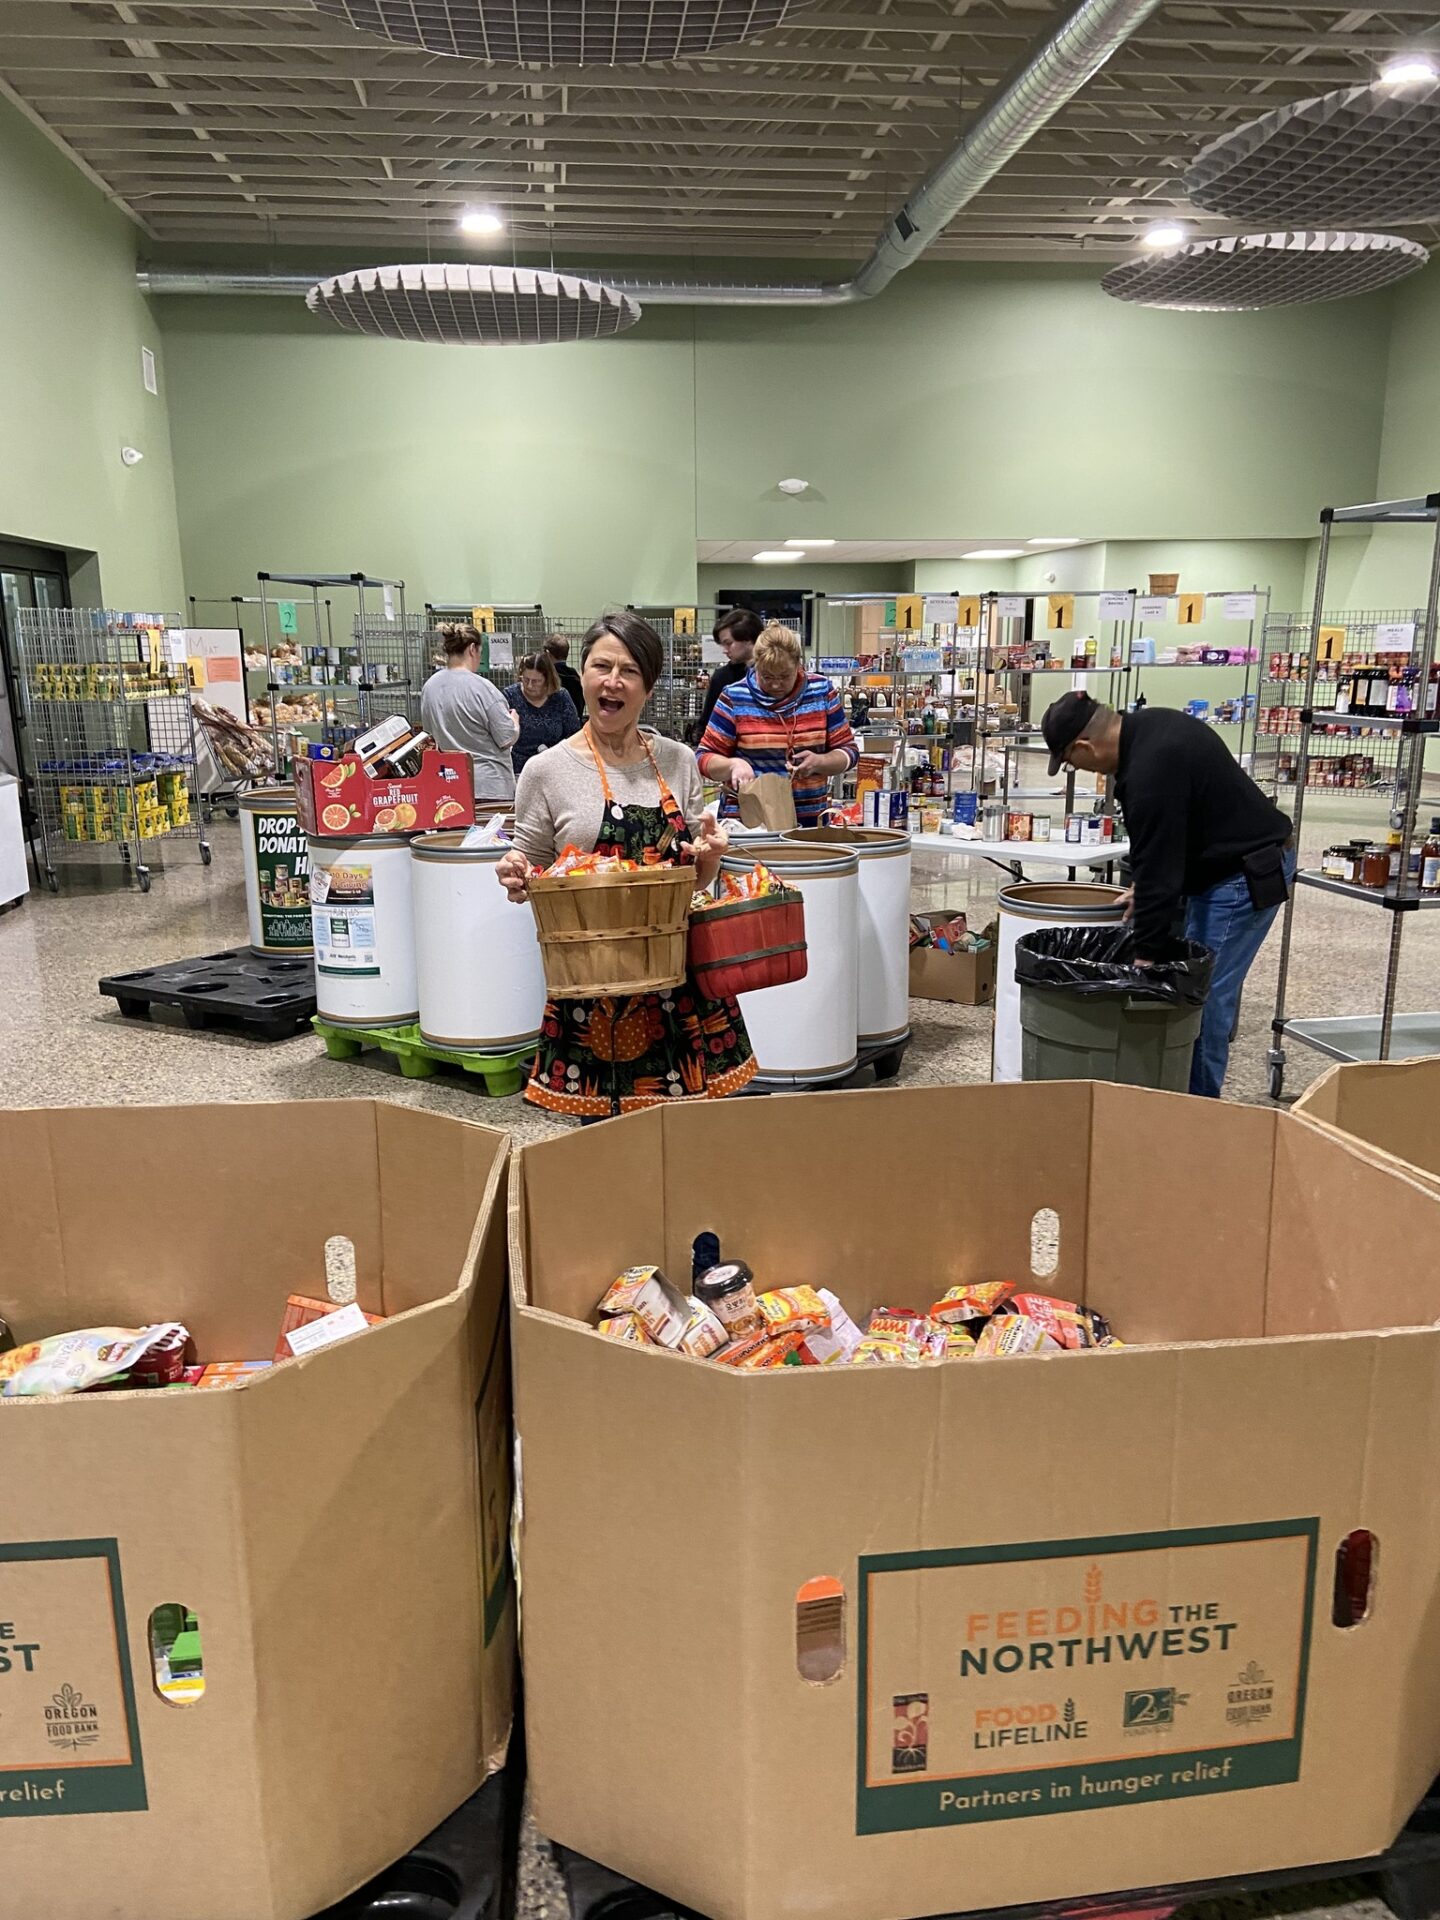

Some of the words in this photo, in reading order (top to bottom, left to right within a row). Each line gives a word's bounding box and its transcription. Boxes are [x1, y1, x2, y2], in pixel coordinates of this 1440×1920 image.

[284, 611, 293, 628] 2
[904, 606, 912, 628] 1
[965, 607, 971, 626] 1
[1055, 606, 1064, 628] 1
[1186, 603, 1194, 623] 1
[680, 616, 687, 633] 1
[1324, 636, 1334, 659] 1
[373, 794, 418, 806] GRAPEFRUIT
[258, 817, 297, 835] DROP
[294, 856, 310, 876] H
[869, 1318, 910, 1334] MAMA
[966, 1599, 1159, 1642] FEEDING
[1169, 1603, 1220, 1625] THE
[960, 1623, 1238, 1677] NORTHWEST
[1227, 1686, 1274, 1703] OREGON
[45, 1707, 98, 1720] OREGON
[974, 1703, 1058, 1729] FOOD
[47, 1725, 72, 1737] FOOD
[74, 1724, 99, 1734] BANK
[974, 1721, 1089, 1749] LIFELINE
[0, 1779, 66, 1802] relief
[940, 1787, 1042, 1811] Partners
[1051, 1782, 1071, 1798] in
[1081, 1774, 1163, 1797] hunger
[1172, 1757, 1233, 1785] relief
